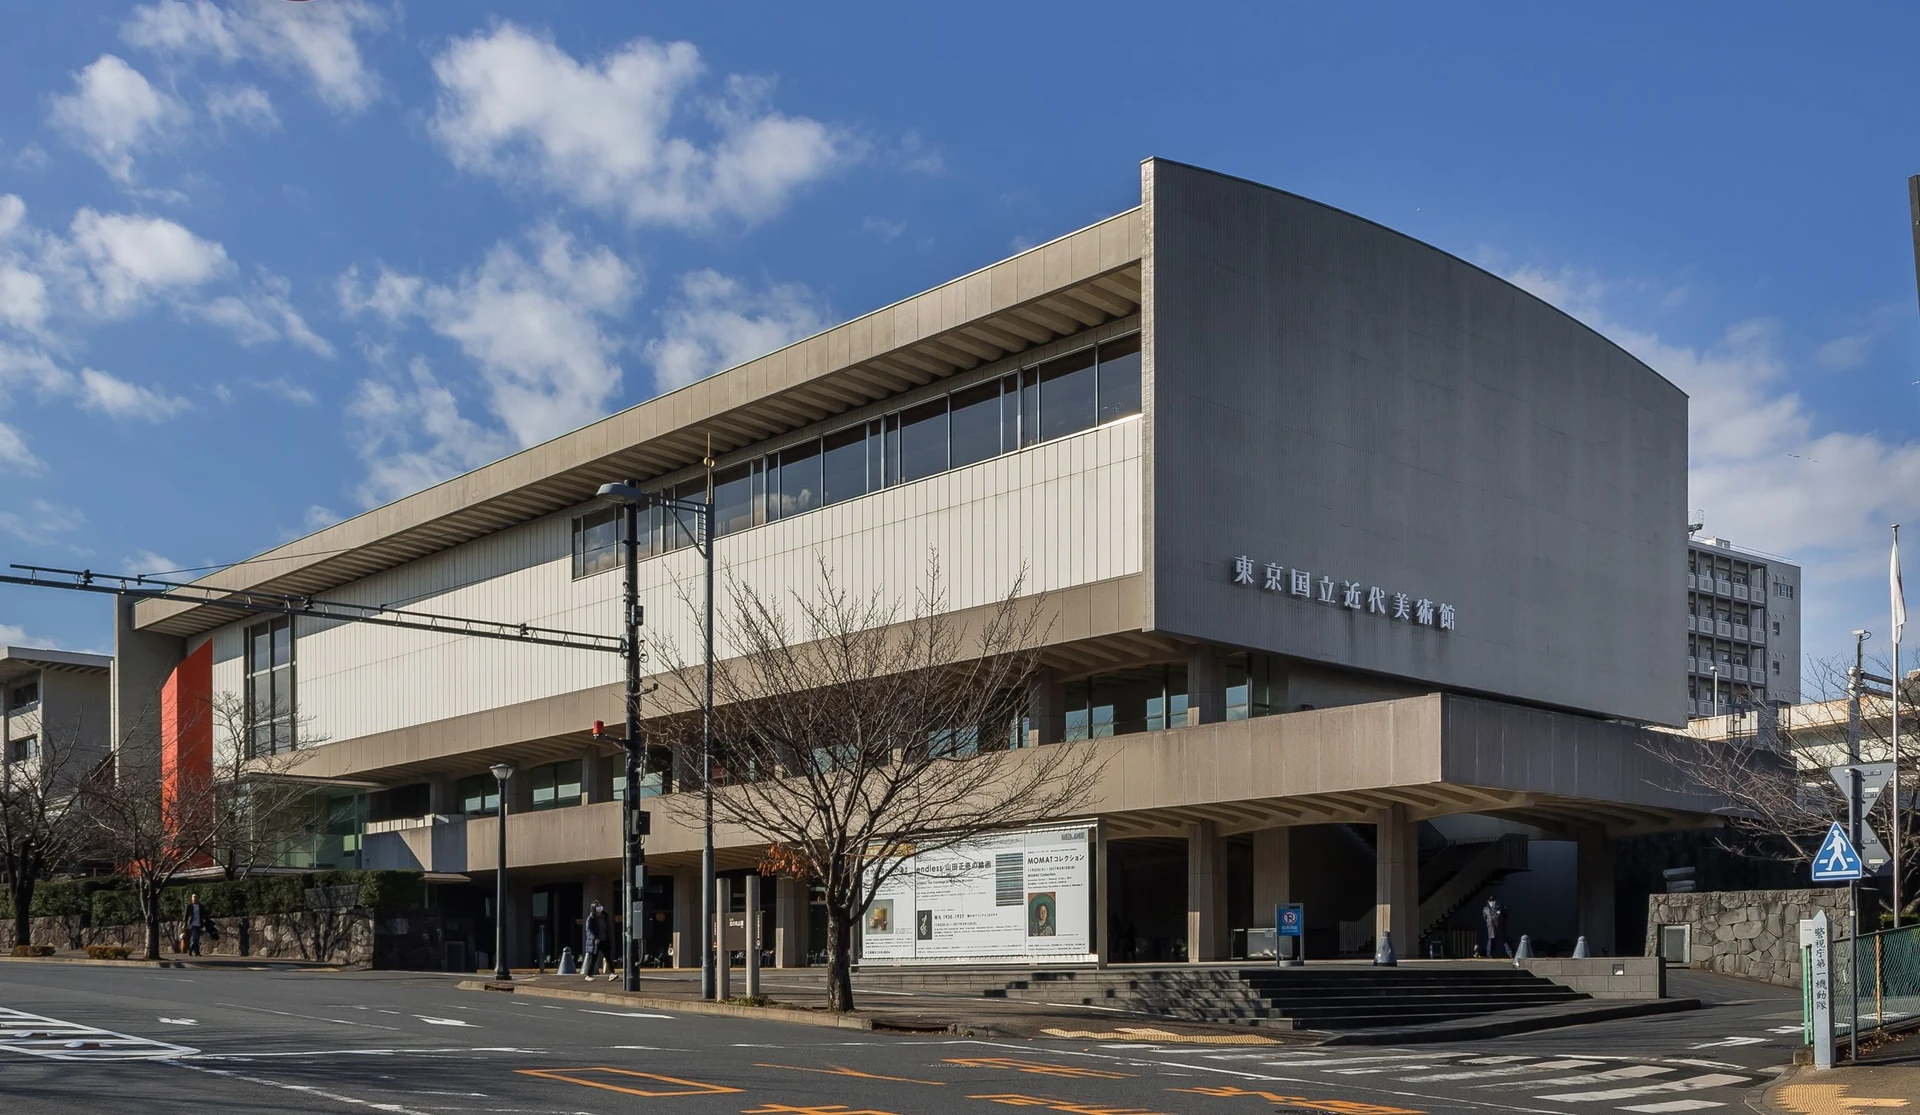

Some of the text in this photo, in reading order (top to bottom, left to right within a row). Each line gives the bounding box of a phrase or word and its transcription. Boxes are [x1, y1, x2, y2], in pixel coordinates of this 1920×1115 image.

[1234, 555, 1456, 631] 東京国立近代美術館
[1814, 927, 1828, 1011] 警視庁第一機動隊
